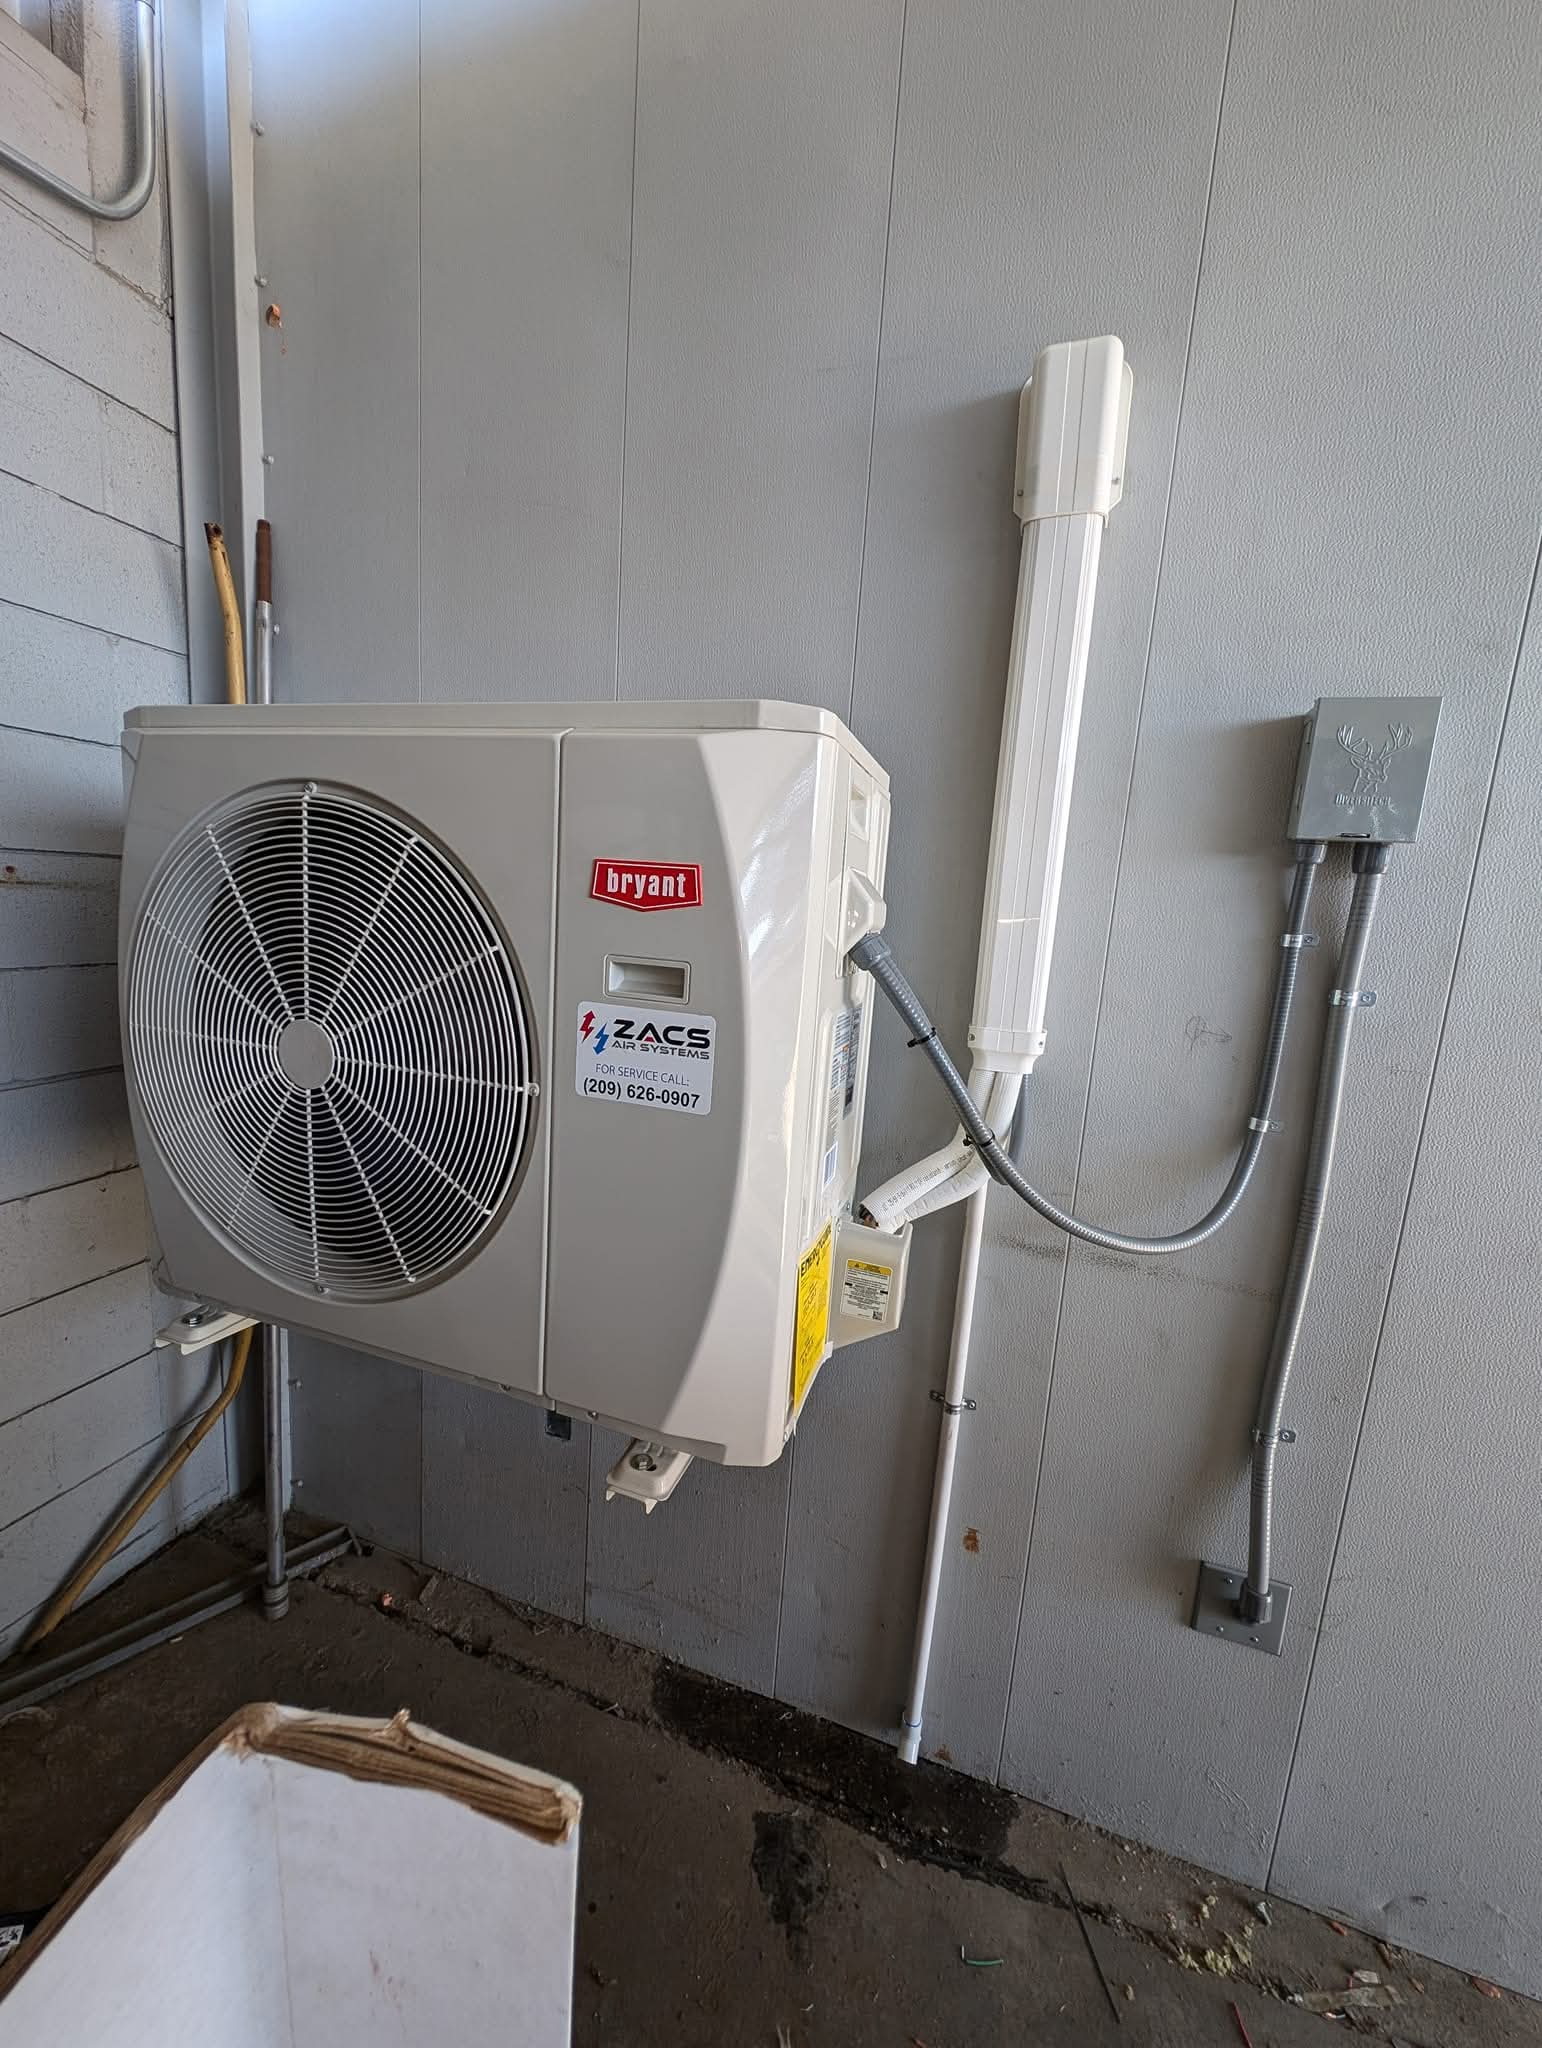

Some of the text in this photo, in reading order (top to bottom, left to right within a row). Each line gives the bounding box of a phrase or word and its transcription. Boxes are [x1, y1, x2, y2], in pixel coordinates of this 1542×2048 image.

[607, 868, 686, 899] bryant
[613, 1019, 711, 1049] ZACS
[611, 1040, 710, 1060] AIR SYSTEMS
[595, 1063, 690, 1087] FOR SERVICE CALL:
[583, 1077, 700, 1109] (209) 626-0907
